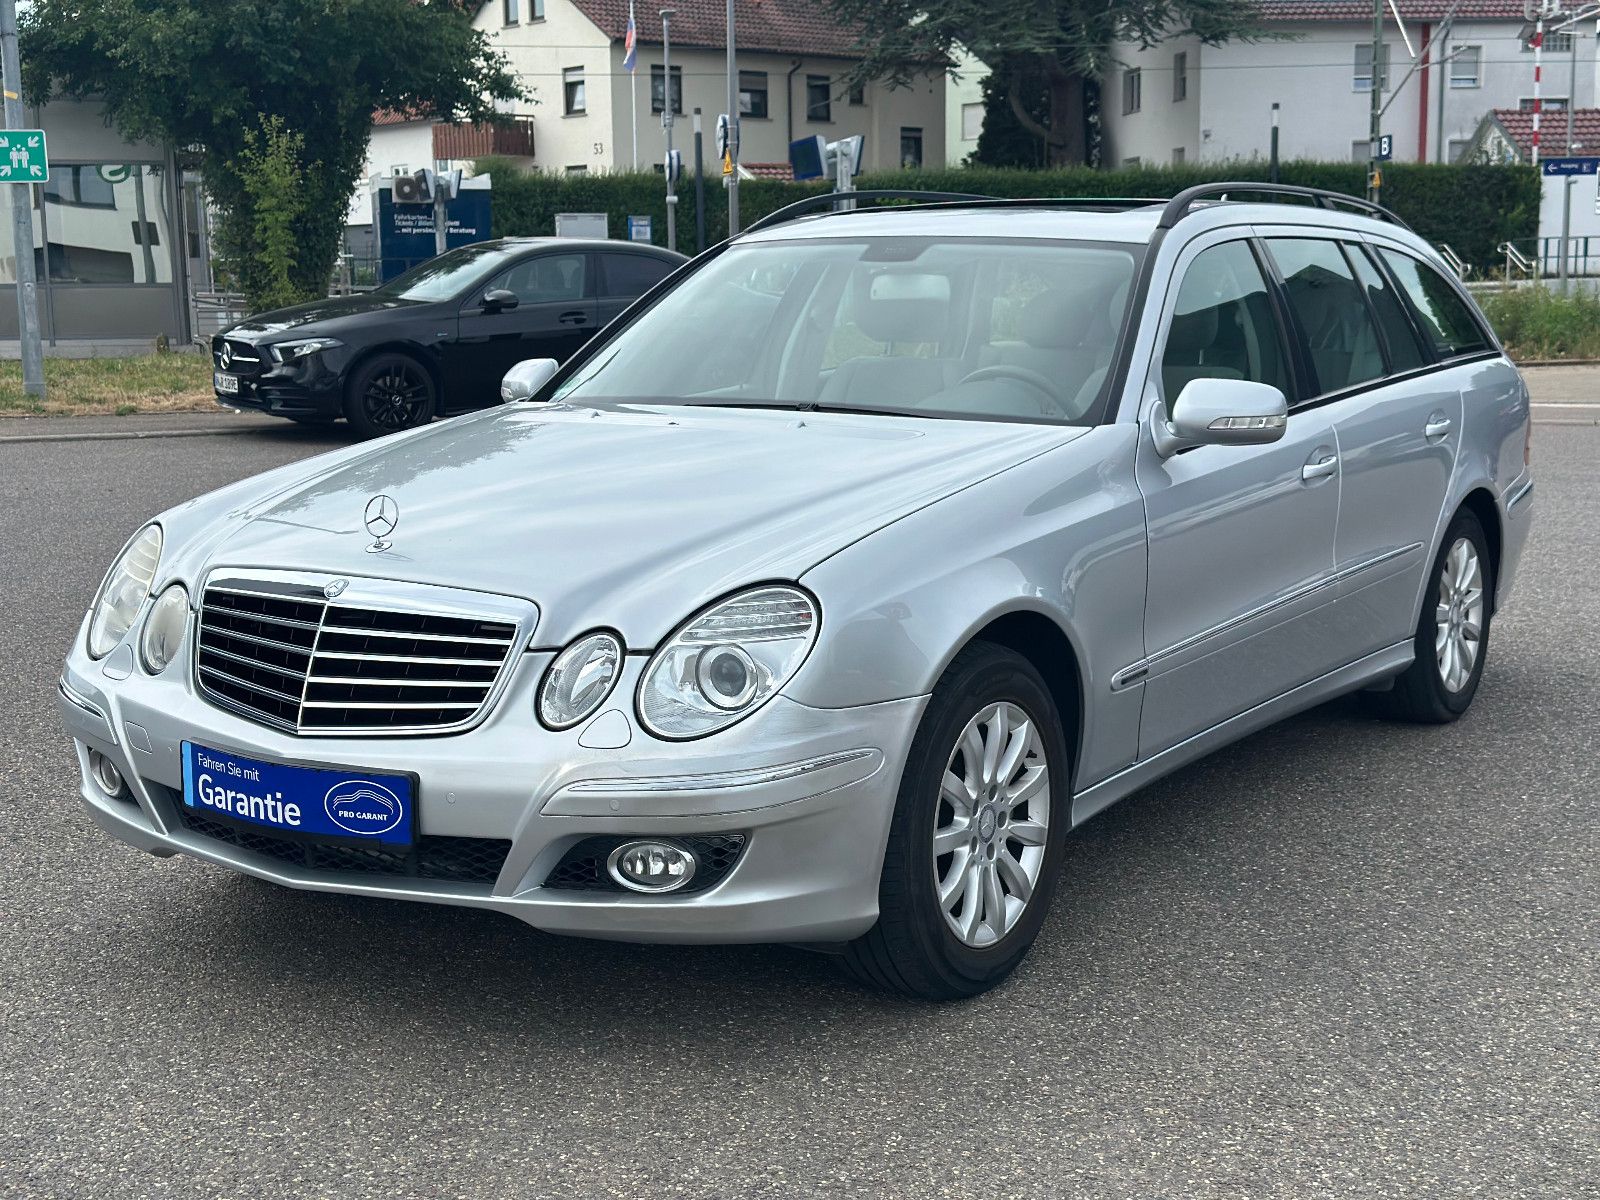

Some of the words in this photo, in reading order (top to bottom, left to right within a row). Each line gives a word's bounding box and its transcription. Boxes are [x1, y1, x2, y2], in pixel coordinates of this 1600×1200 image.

[594, 142, 603, 155] 53
[1381, 137, 1389, 155] B
[449, 227, 476, 235] Beratung
[197, 752, 226, 773] Fahren
[227, 762, 242, 777] Sie
[243, 767, 260, 782] mit
[198, 773, 300, 826] Garantie
[338, 810, 355, 819] PRO
[356, 811, 388, 821] GARANT
